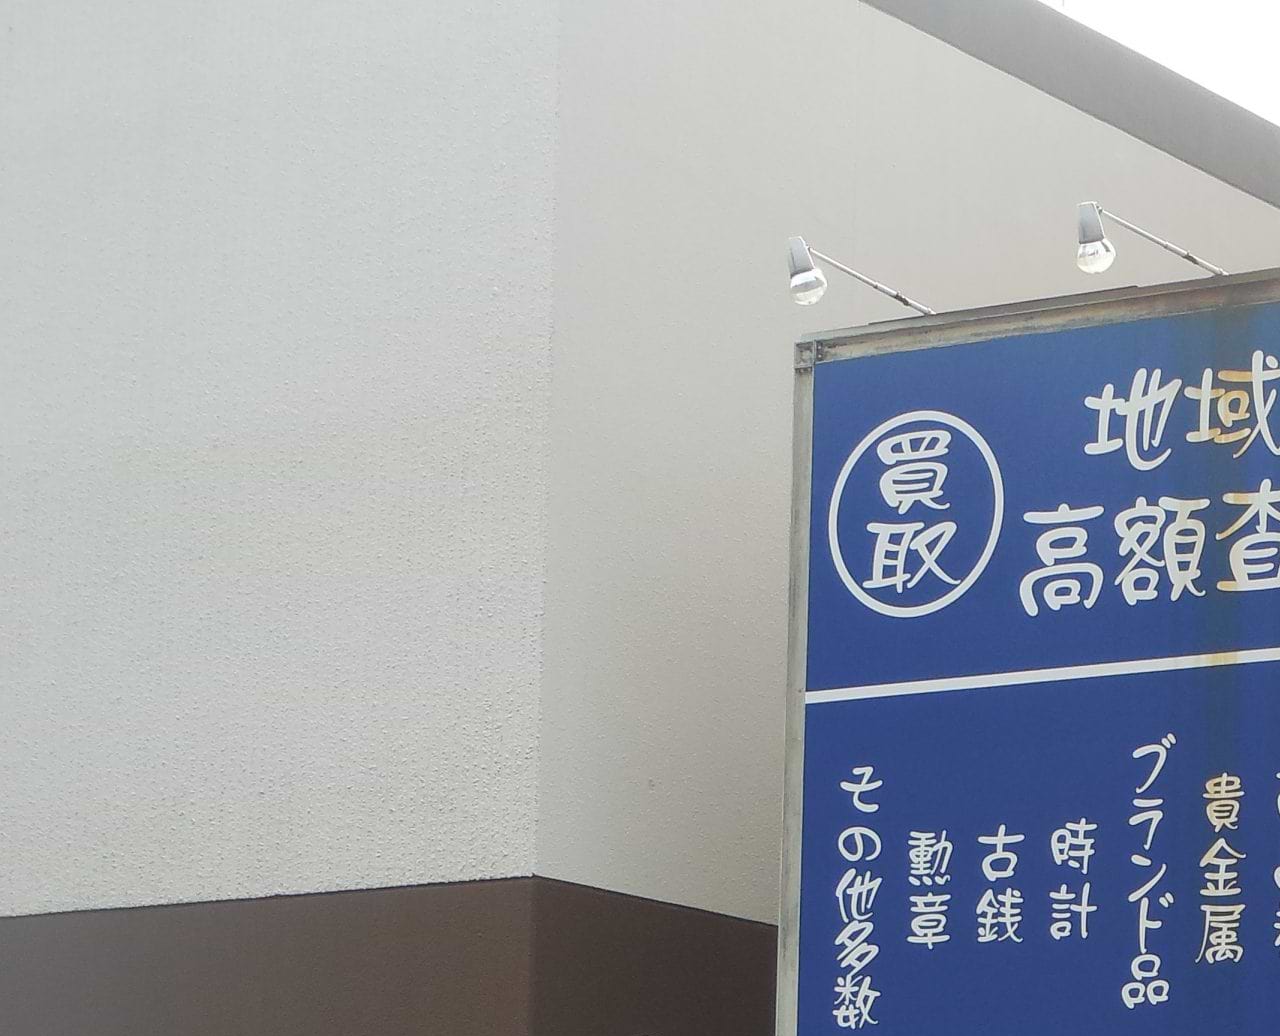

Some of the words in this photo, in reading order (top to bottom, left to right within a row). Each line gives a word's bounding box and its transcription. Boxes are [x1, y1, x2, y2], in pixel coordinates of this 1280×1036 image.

[865, 429, 962, 595] 買取
[832, 764, 883, 1031] その他多数
[908, 829, 953, 949] 勲章
[977, 825, 1025, 944] 古銭
[1050, 818, 1097, 940] 時計
[1121, 733, 1179, 1008] ブランド品
[1195, 772, 1245, 965] 貴金属
